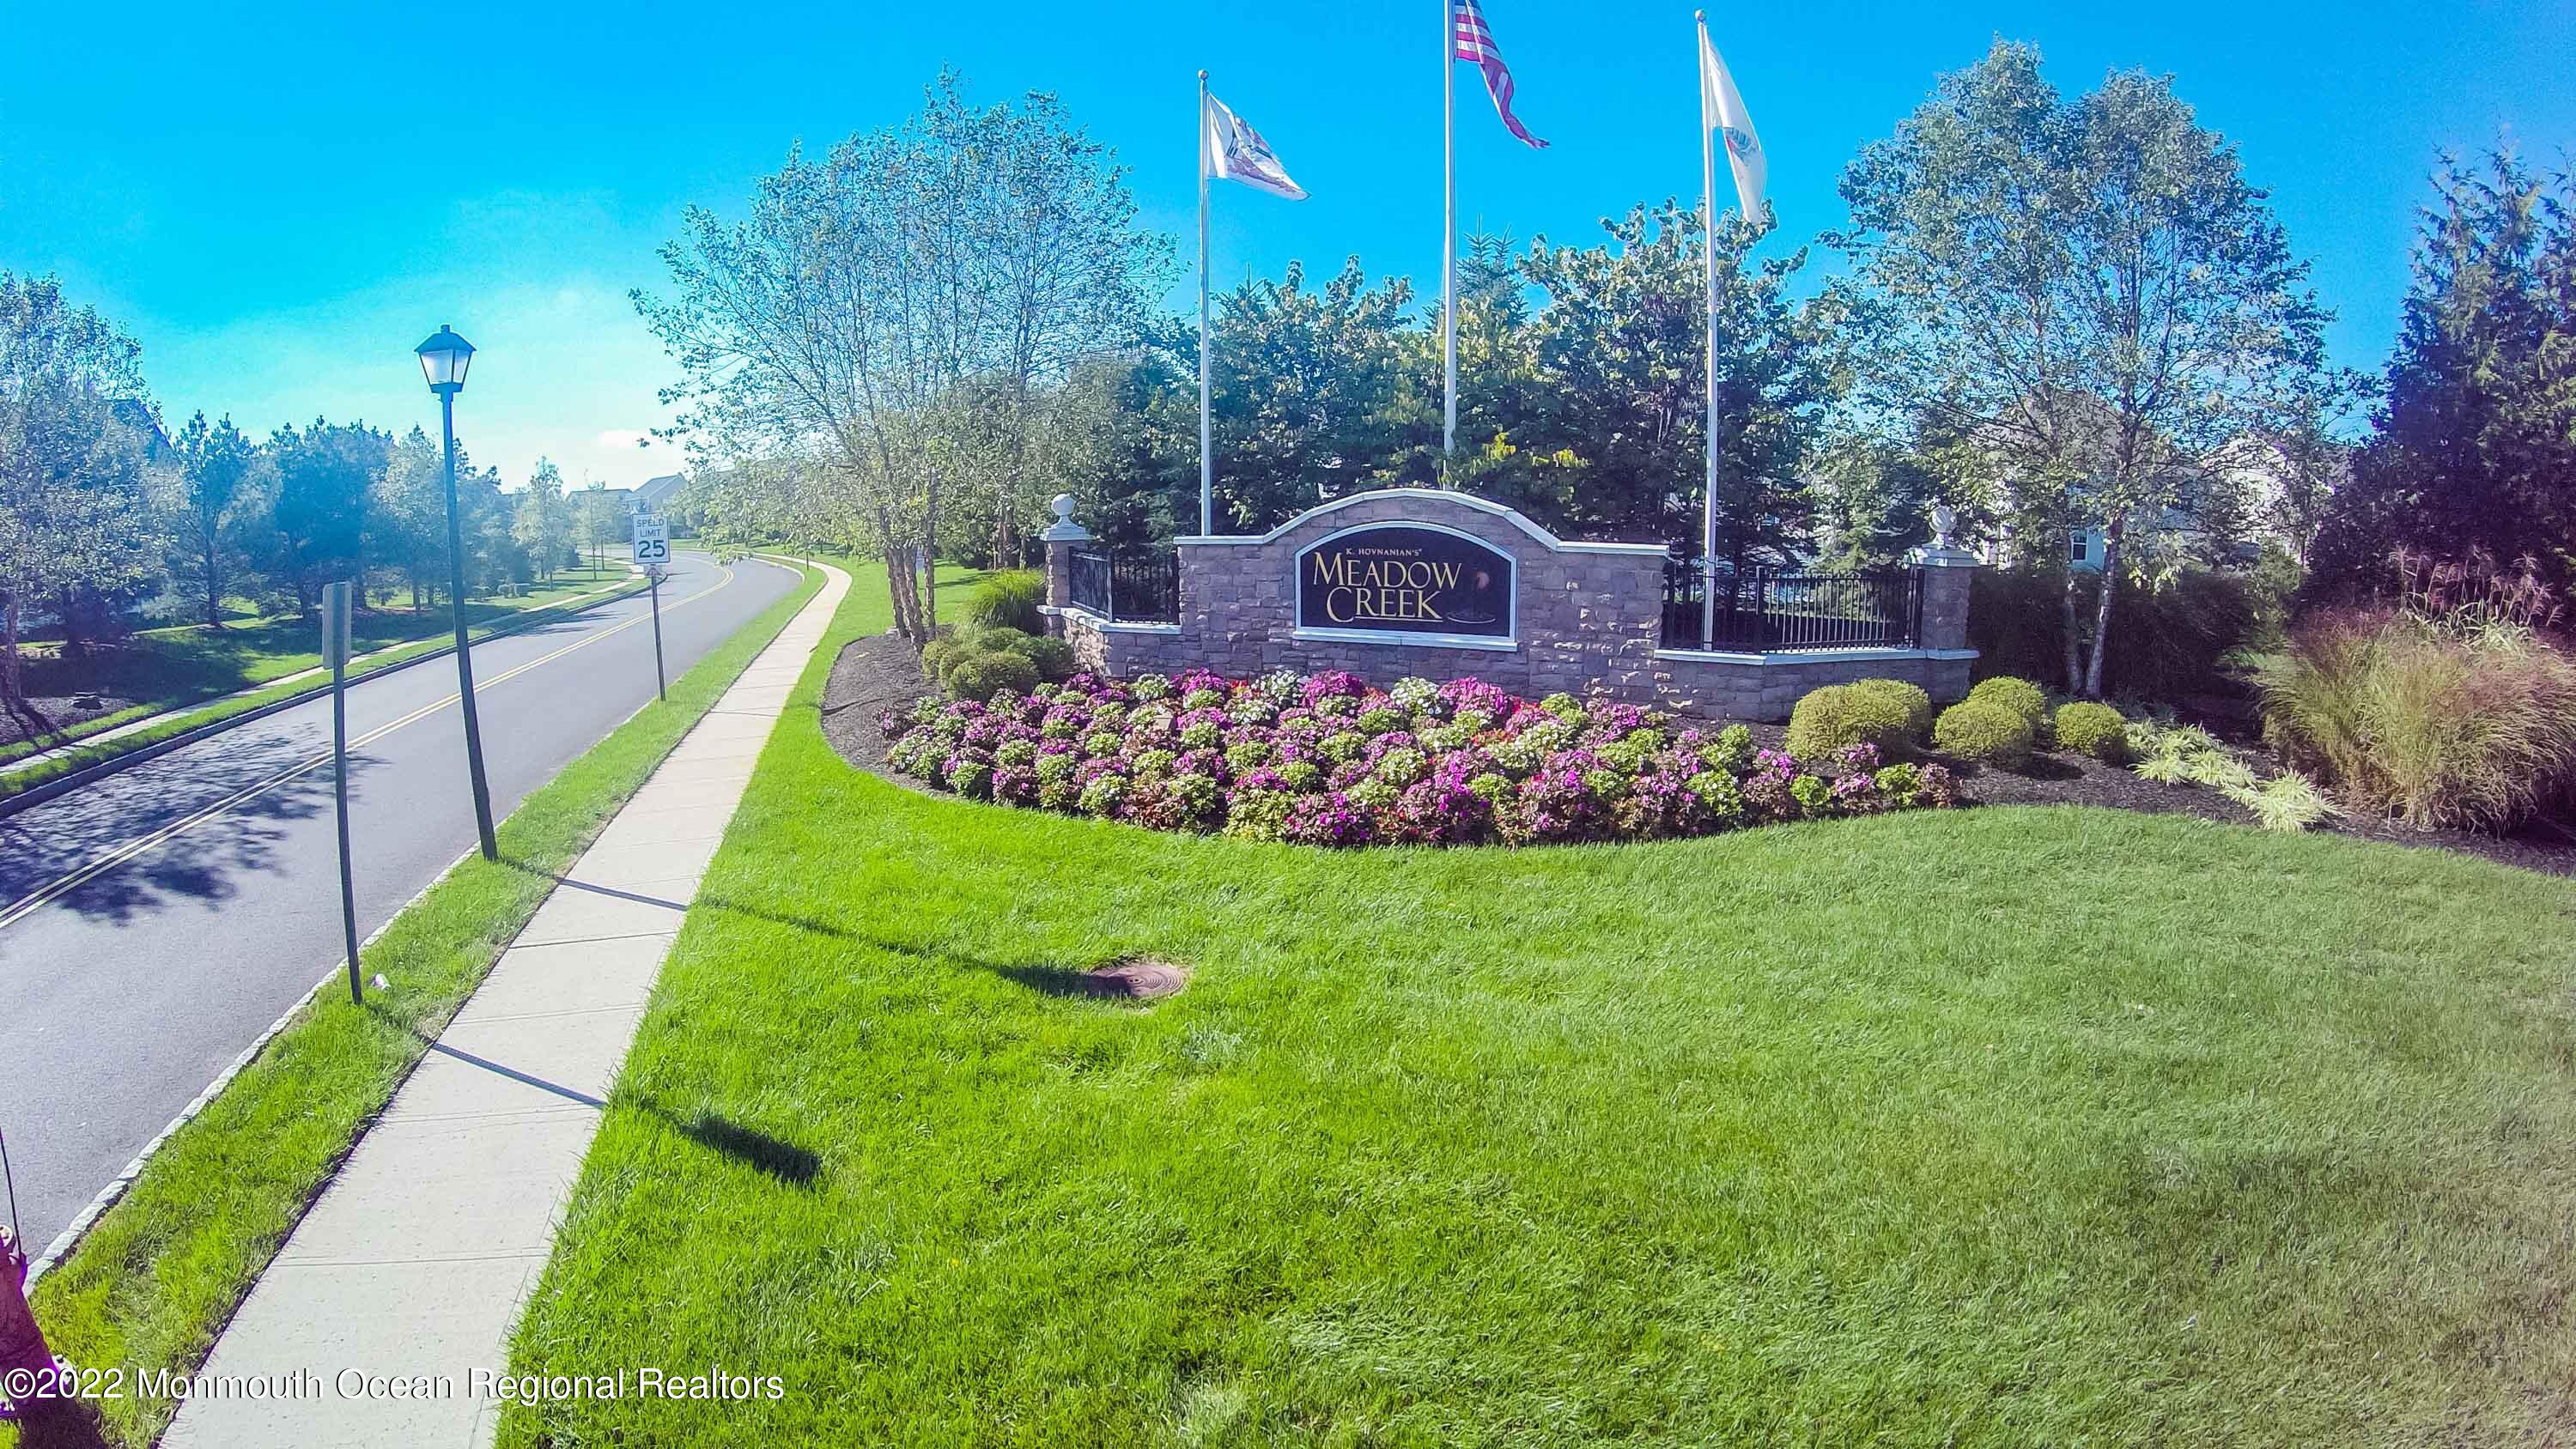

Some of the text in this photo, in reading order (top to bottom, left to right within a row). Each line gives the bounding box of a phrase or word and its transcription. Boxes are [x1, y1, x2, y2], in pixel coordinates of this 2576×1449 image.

[640, 528, 662, 537] LIMIT
[638, 539, 665, 558] 25
[1358, 548, 1420, 556] HOVNANIAN'S
[1313, 552, 1462, 590] MEADOW
[1326, 586, 1443, 622] CREEK
